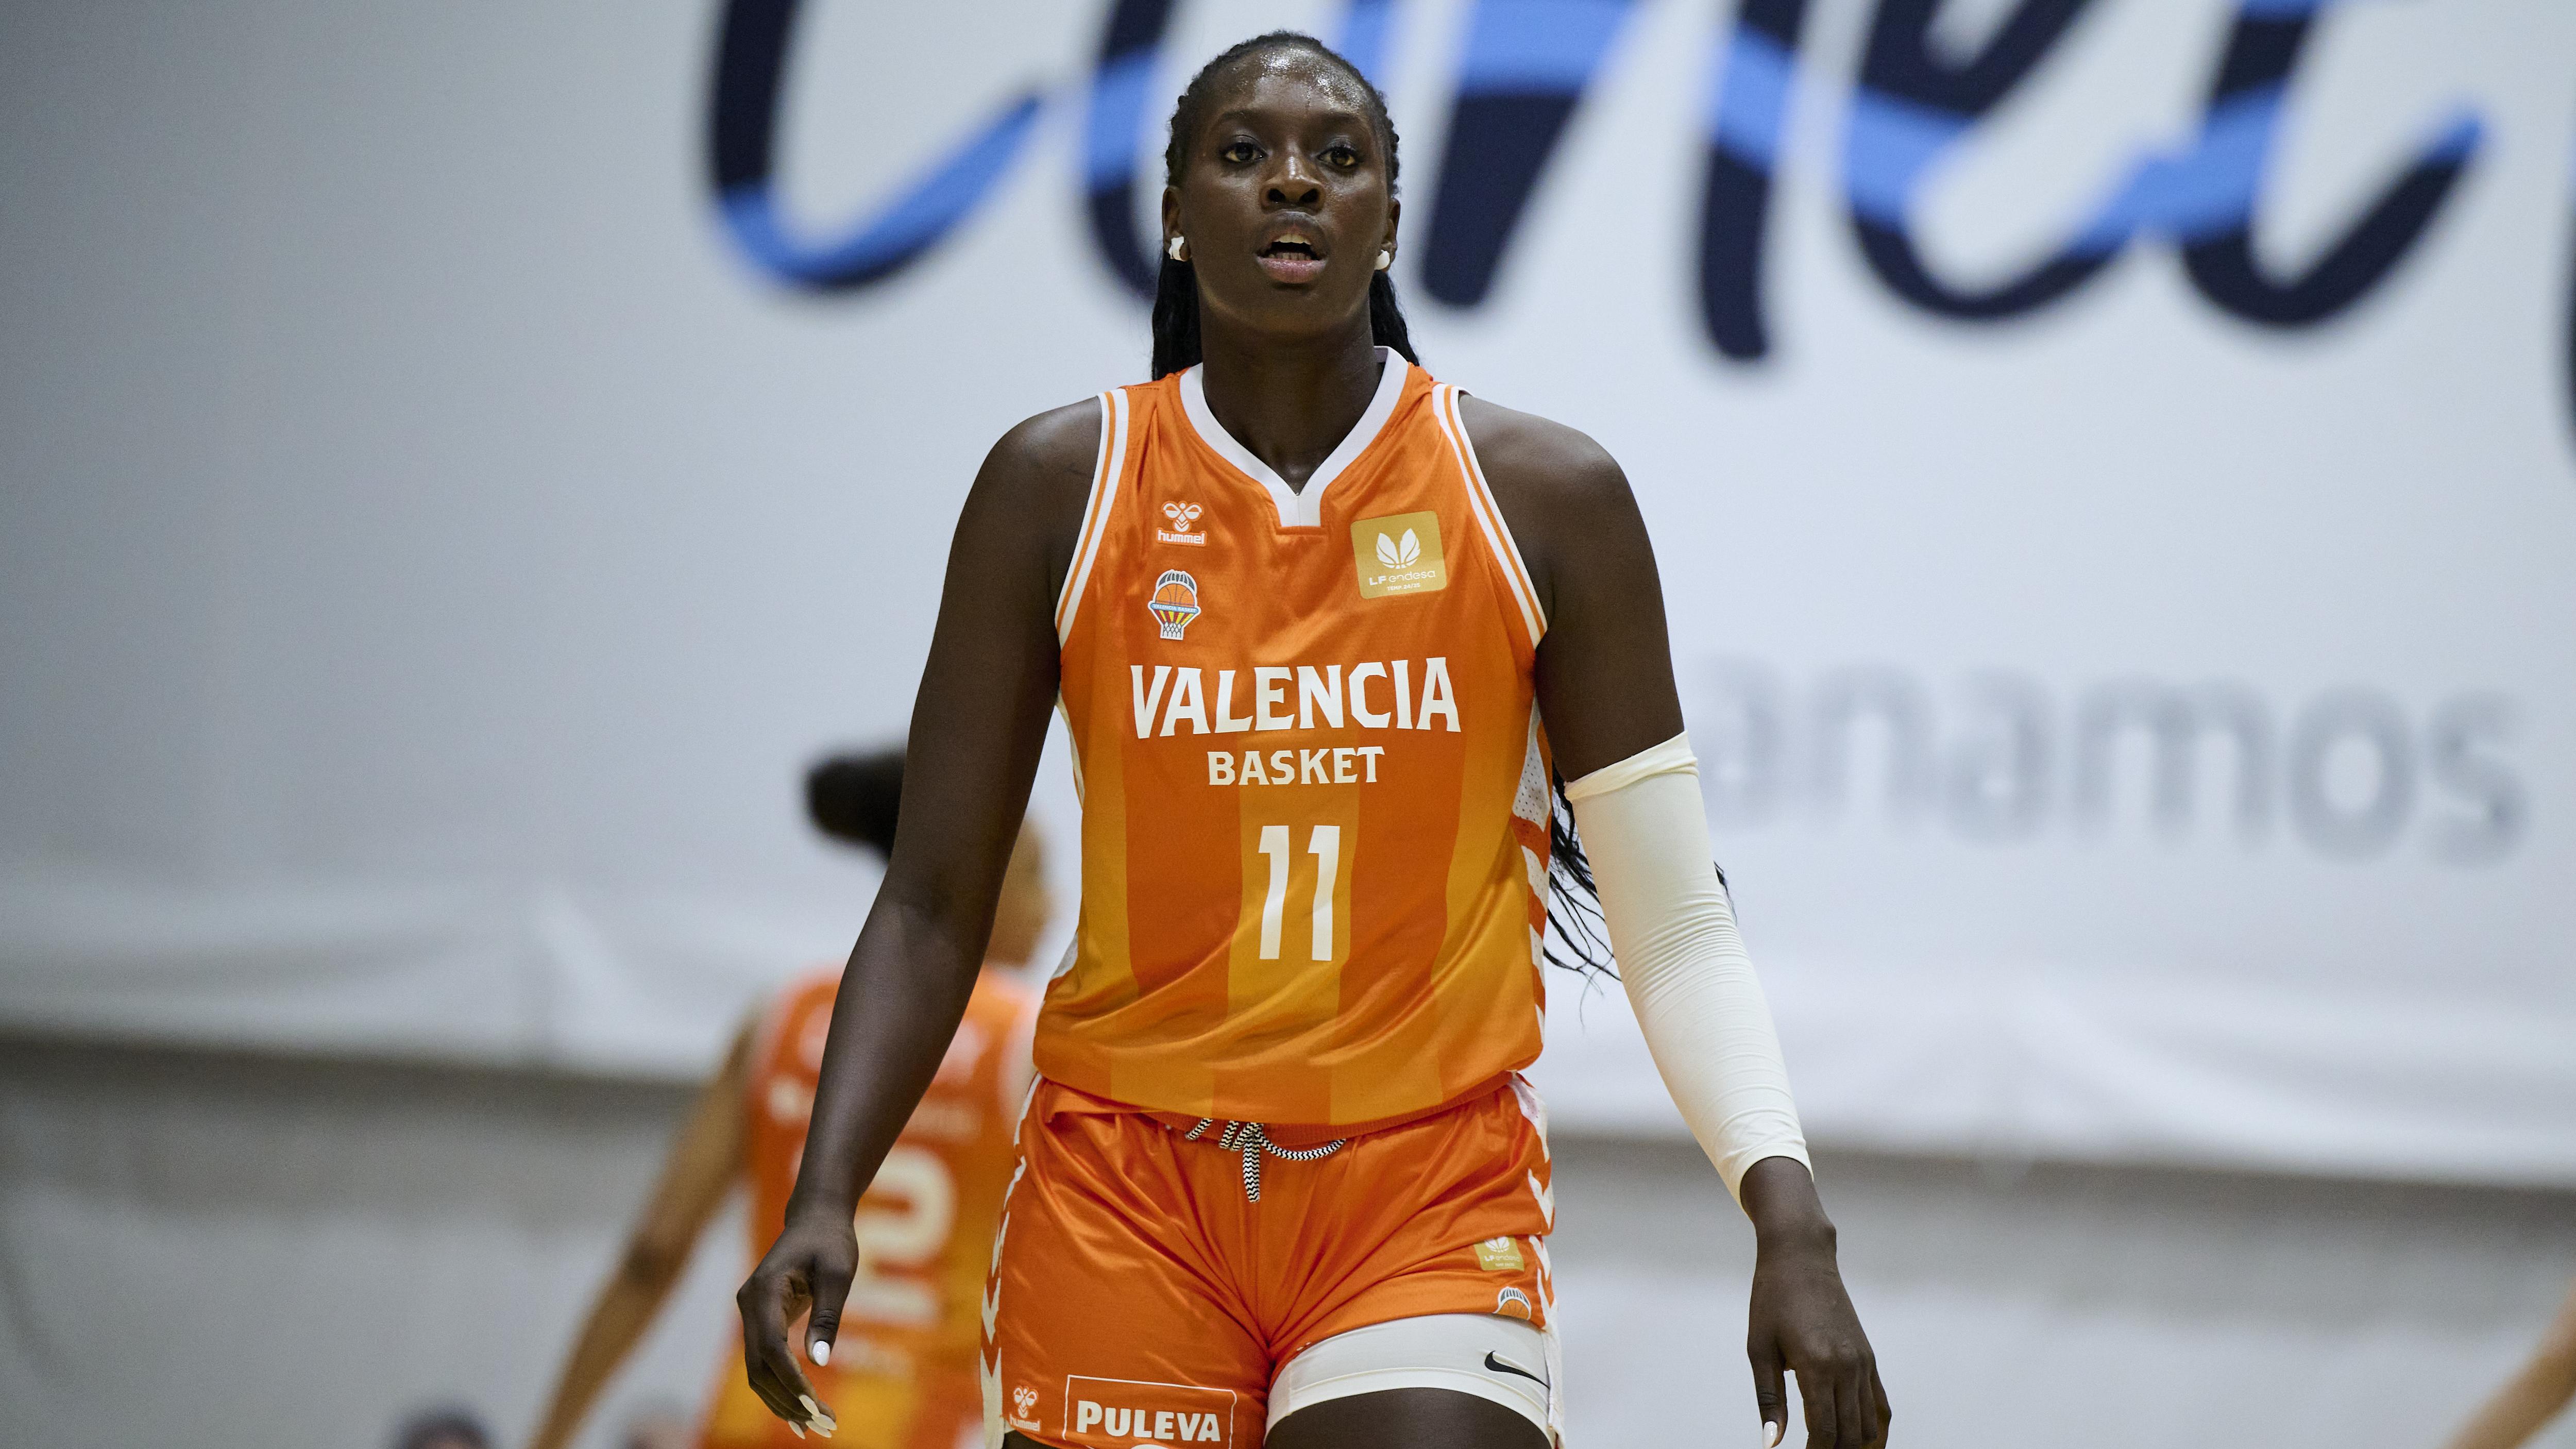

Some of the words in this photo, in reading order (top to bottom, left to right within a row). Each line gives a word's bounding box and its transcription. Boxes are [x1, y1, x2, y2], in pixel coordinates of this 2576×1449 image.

[1158, 529, 1205, 544] hummel
[1368, 575, 1386, 585] LF
[1388, 570, 1436, 582] endesa
[1130, 656, 1461, 739] VALENCIA
[1207, 746, 1385, 785] BASKET
[1695, 652, 2530, 871] anamos
[1258, 825, 1340, 961] 11
[1009, 1413, 1040, 1432] hummel
[1077, 1400, 1221, 1442] PULEVA
